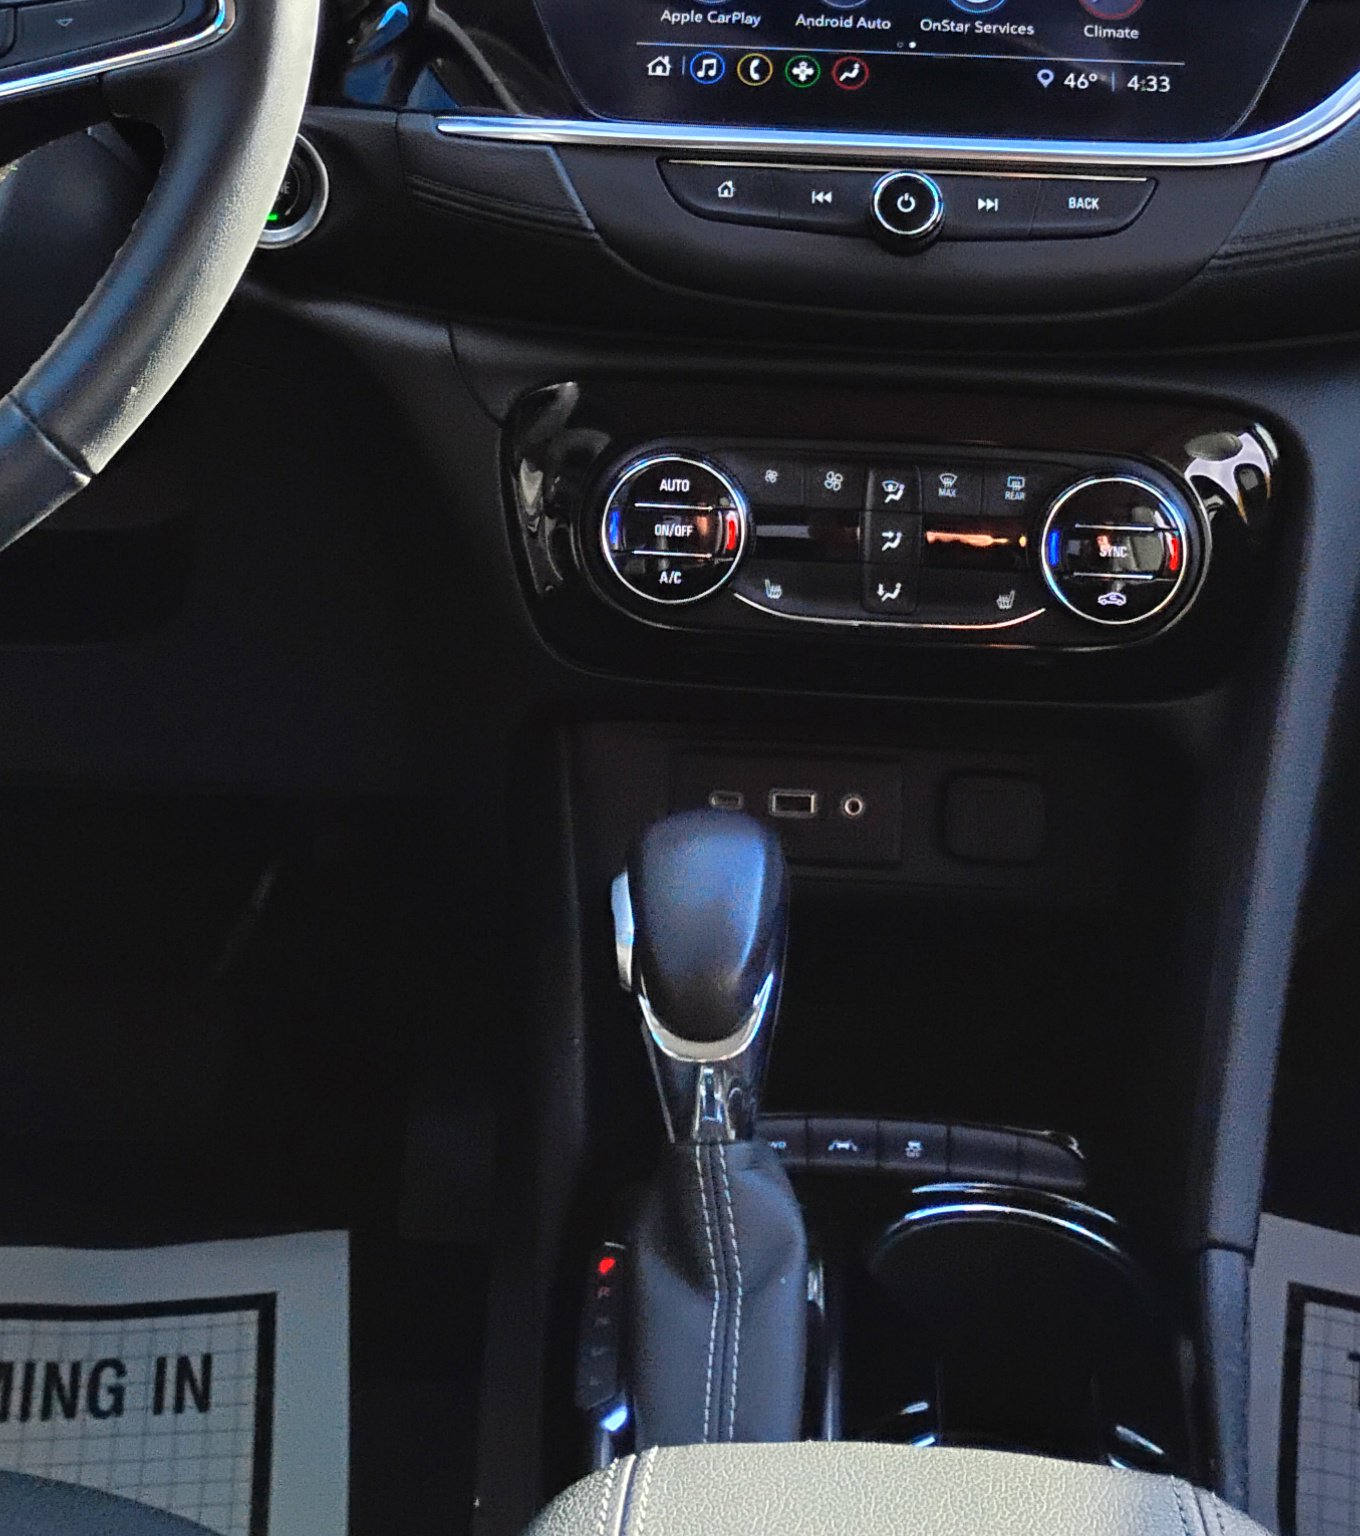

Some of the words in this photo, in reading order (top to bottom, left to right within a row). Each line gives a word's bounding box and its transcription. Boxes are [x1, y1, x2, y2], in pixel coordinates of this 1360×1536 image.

[660, 9, 703, 25] Apple
[706, 10, 762, 28] CarPlay
[795, 13, 853, 29] Android
[856, 15, 892, 30] Auto
[919, 18, 971, 35] OnStar
[973, 20, 1035, 36] Services
[1083, 24, 1140, 39] Climate
[1063, 72, 1098, 90] 46°
[1126, 74, 1172, 93] 4:33
[1067, 196, 1100, 210] BACK
[659, 478, 691, 493] AUTO
[938, 487, 958, 498] MAX
[1004, 489, 1026, 501] REAR
[654, 522, 694, 538] ON/OFF
[1098, 545, 1128, 559] SYNC
[658, 570, 683, 585] A/C
[149, 1352, 214, 1415] IN
